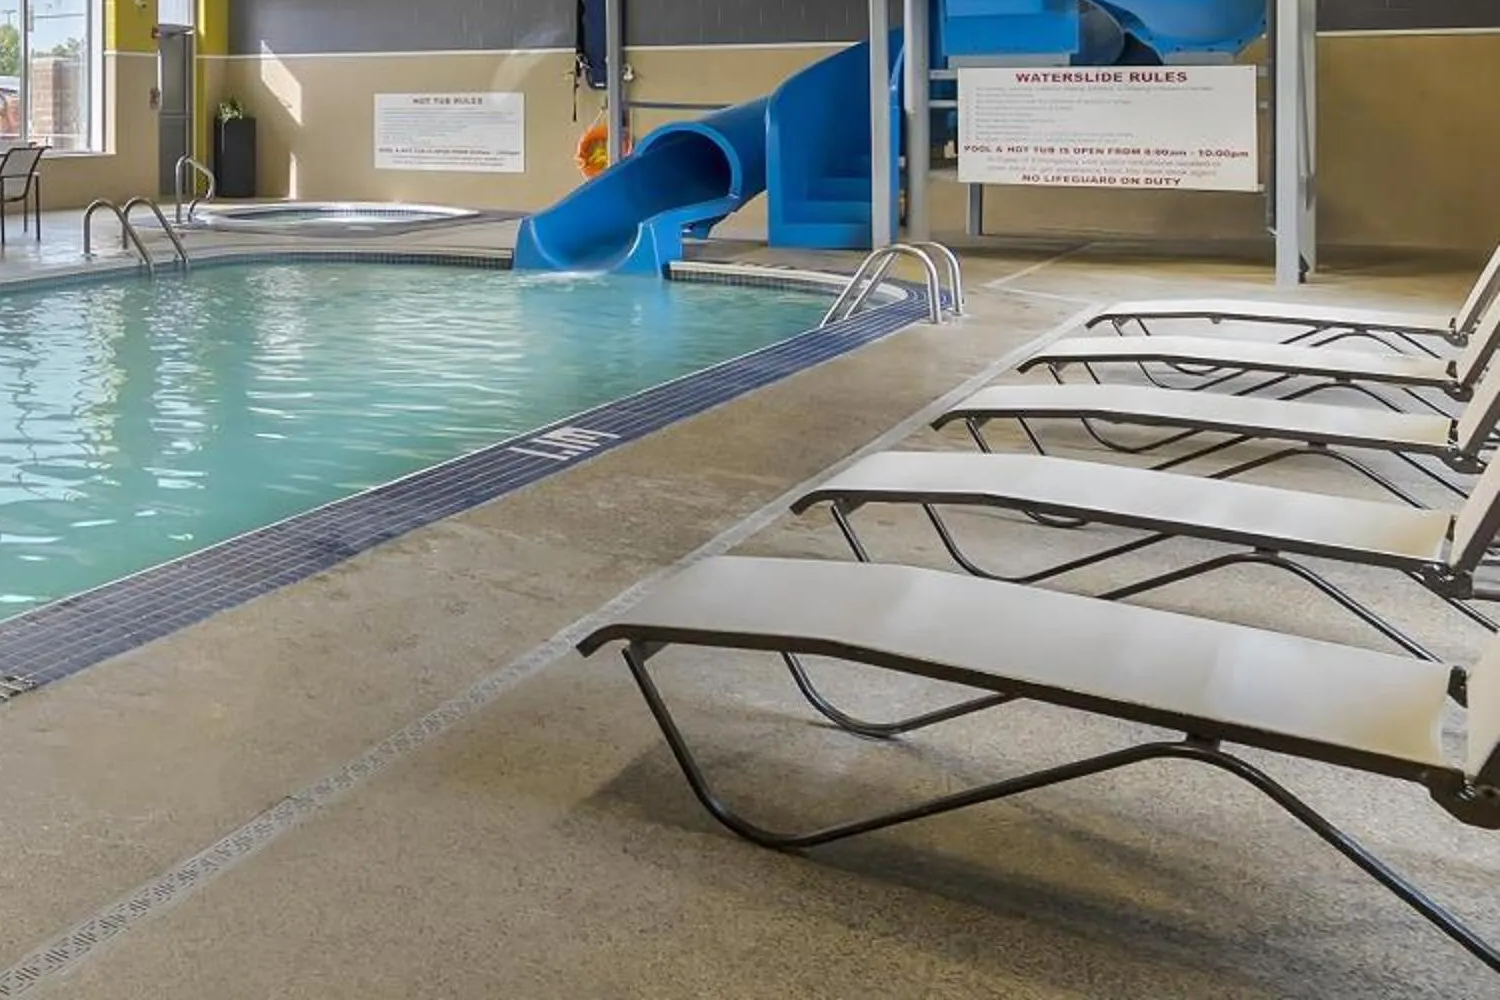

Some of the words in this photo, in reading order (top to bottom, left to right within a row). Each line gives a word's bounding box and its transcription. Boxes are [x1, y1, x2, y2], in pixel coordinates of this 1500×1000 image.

[1015, 71, 1123, 83] WATERSLIDE
[1129, 70, 1188, 84] RULES
[963, 145, 990, 153] POOL
[1007, 145, 1028, 153] HOT
[1073, 147, 1104, 155] OPEN
[1107, 147, 1140, 155] FROM
[1022, 174, 1040, 182] NO
[1044, 175, 1116, 184] LIFEGUARD
[1120, 176, 1140, 184] ON
[1145, 177, 1181, 185] DUTY
